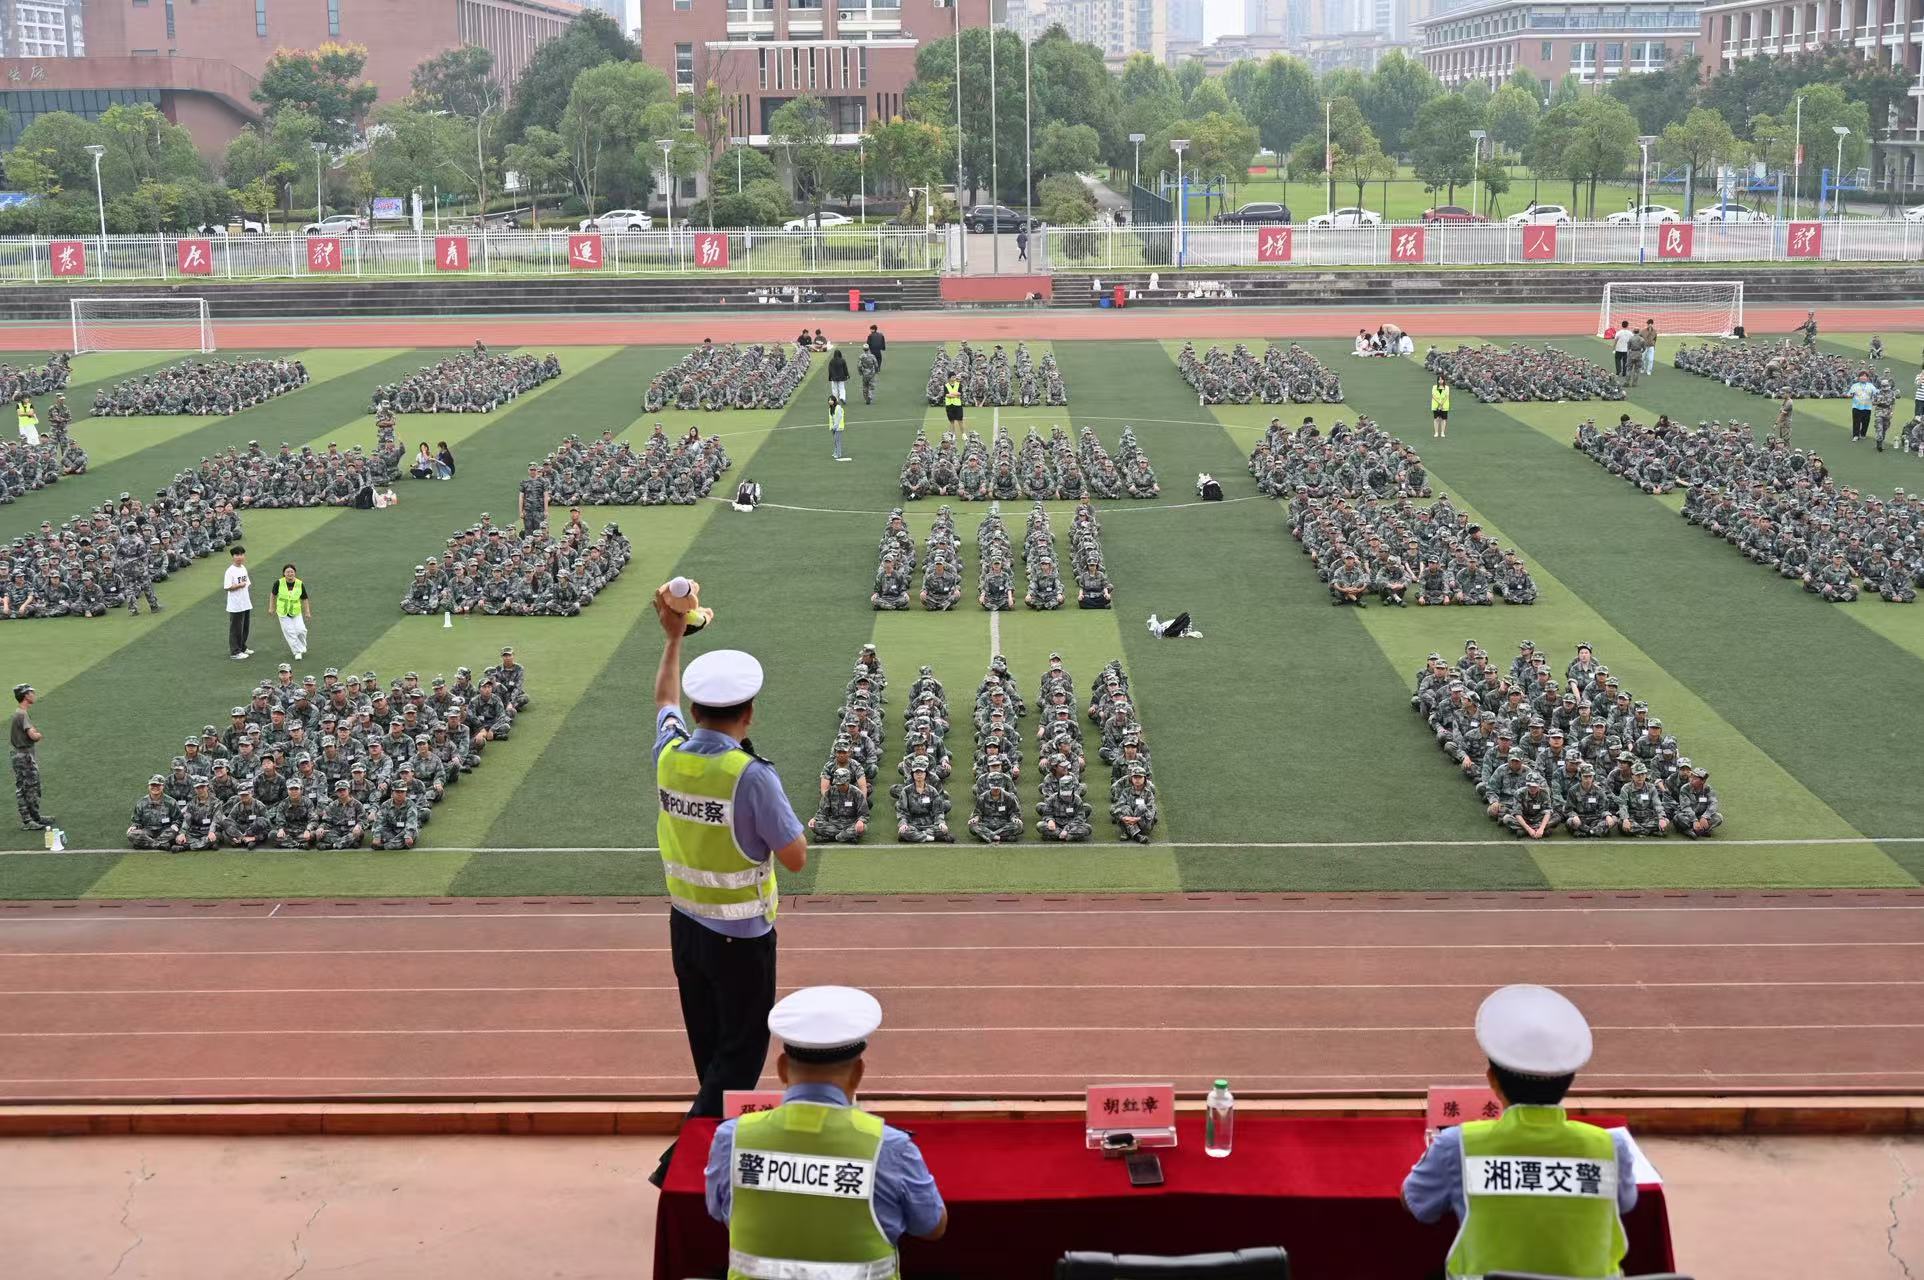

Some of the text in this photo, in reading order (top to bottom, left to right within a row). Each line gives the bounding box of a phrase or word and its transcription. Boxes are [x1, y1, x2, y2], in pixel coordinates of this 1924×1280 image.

[445, 239, 459, 267] 育
[1261, 230, 1288, 257] 增
[1528, 230, 1551, 253] 人
[1665, 226, 1684, 254] 民
[1483, 1159, 1602, 1195] 湘潭交警
